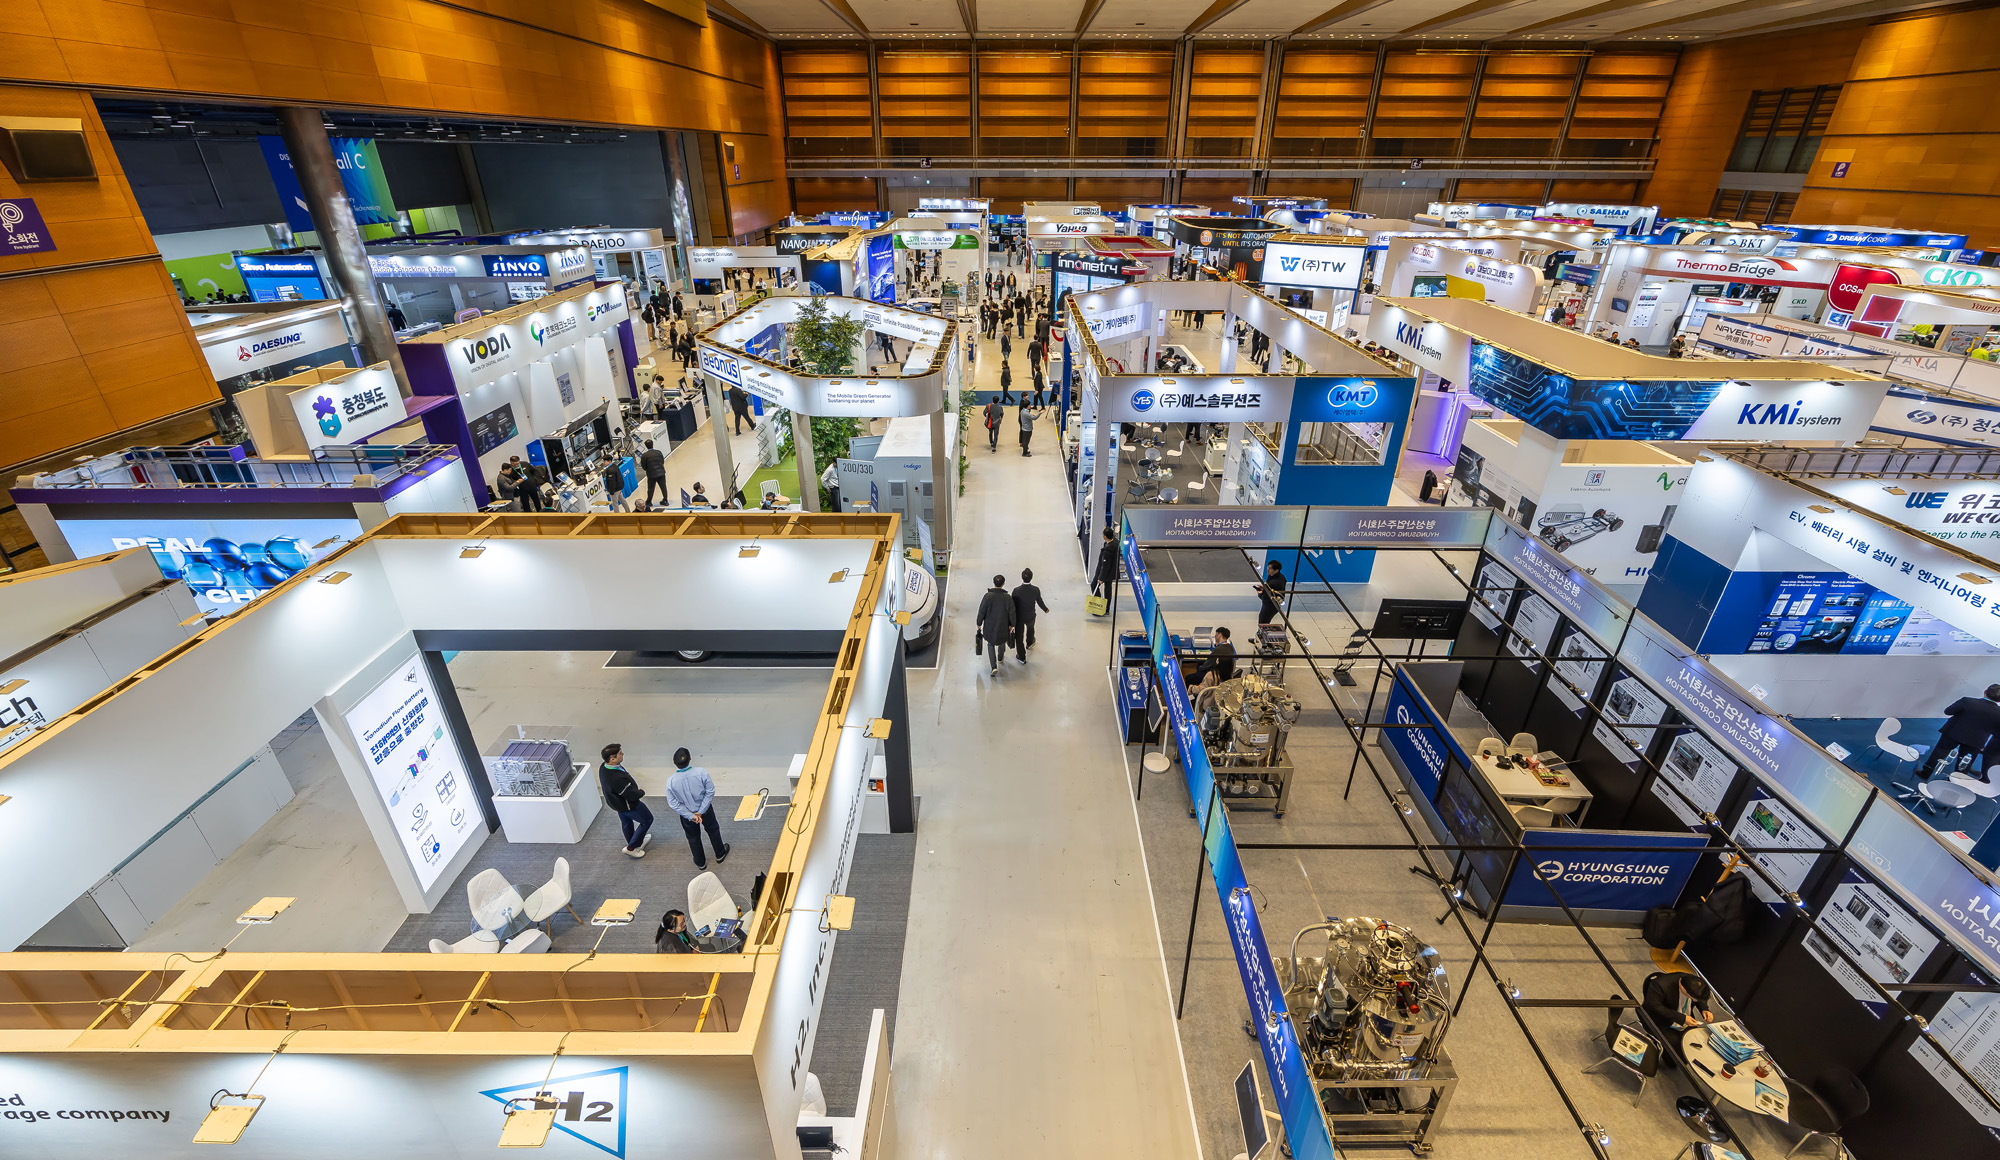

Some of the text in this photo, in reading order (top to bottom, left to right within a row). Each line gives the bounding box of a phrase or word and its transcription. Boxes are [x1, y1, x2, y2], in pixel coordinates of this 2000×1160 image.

[354, 153, 366, 170] C
[839, 210, 869, 226] envision
[1590, 208, 1629, 216] SAEHAN
[8, 232, 39, 245] 소화전
[581, 238, 625, 249] DAEJOO
[1739, 239, 1766, 248] BKT
[1412, 246, 1435, 258] KOSDAQ
[265, 263, 313, 271] Automation
[1058, 256, 1118, 275] innometry
[1676, 258, 1776, 278] Thermo Bridge
[1925, 267, 1983, 286] CKD
[596, 302, 623, 317] PCM Solution
[864, 312, 880, 323] aeonus
[883, 318, 897, 327] Infinite
[897, 321, 921, 332] Possibilities
[1396, 320, 1442, 361] KMi system
[1715, 324, 1772, 344] NAVECTOR
[252, 332, 301, 353] DAESUNG
[462, 332, 512, 364] VODA
[702, 351, 739, 379] aeonus
[342, 386, 387, 415] 충청북도
[761, 387, 778, 401] company
[1134, 396, 1154, 405] YES
[1160, 394, 1261, 409] (주)예스솔루션즈
[1335, 390, 1370, 403] KMT
[1737, 400, 1842, 427] KMi system
[1941, 414, 1968, 428] (주)
[842, 463, 874, 475] 200/330
[1905, 492, 1950, 509] WE
[1956, 530, 1967, 538] to
[1970, 530, 1987, 538] the
[1789, 510, 1987, 608] EV, 배터리 시험 설비 및 엔지니어링
[363, 687, 424, 742] Vanadium Flow Battery
[374, 733, 405, 766] 반응으로
[1567, 862, 1670, 875] HYUNGSUNG
[1563, 873, 1665, 886] CORPORATION
[1229, 903, 1253, 979] YUNGSUNG
[534, 1091, 614, 1122] H2
[0, 1109, 171, 1123] age company
